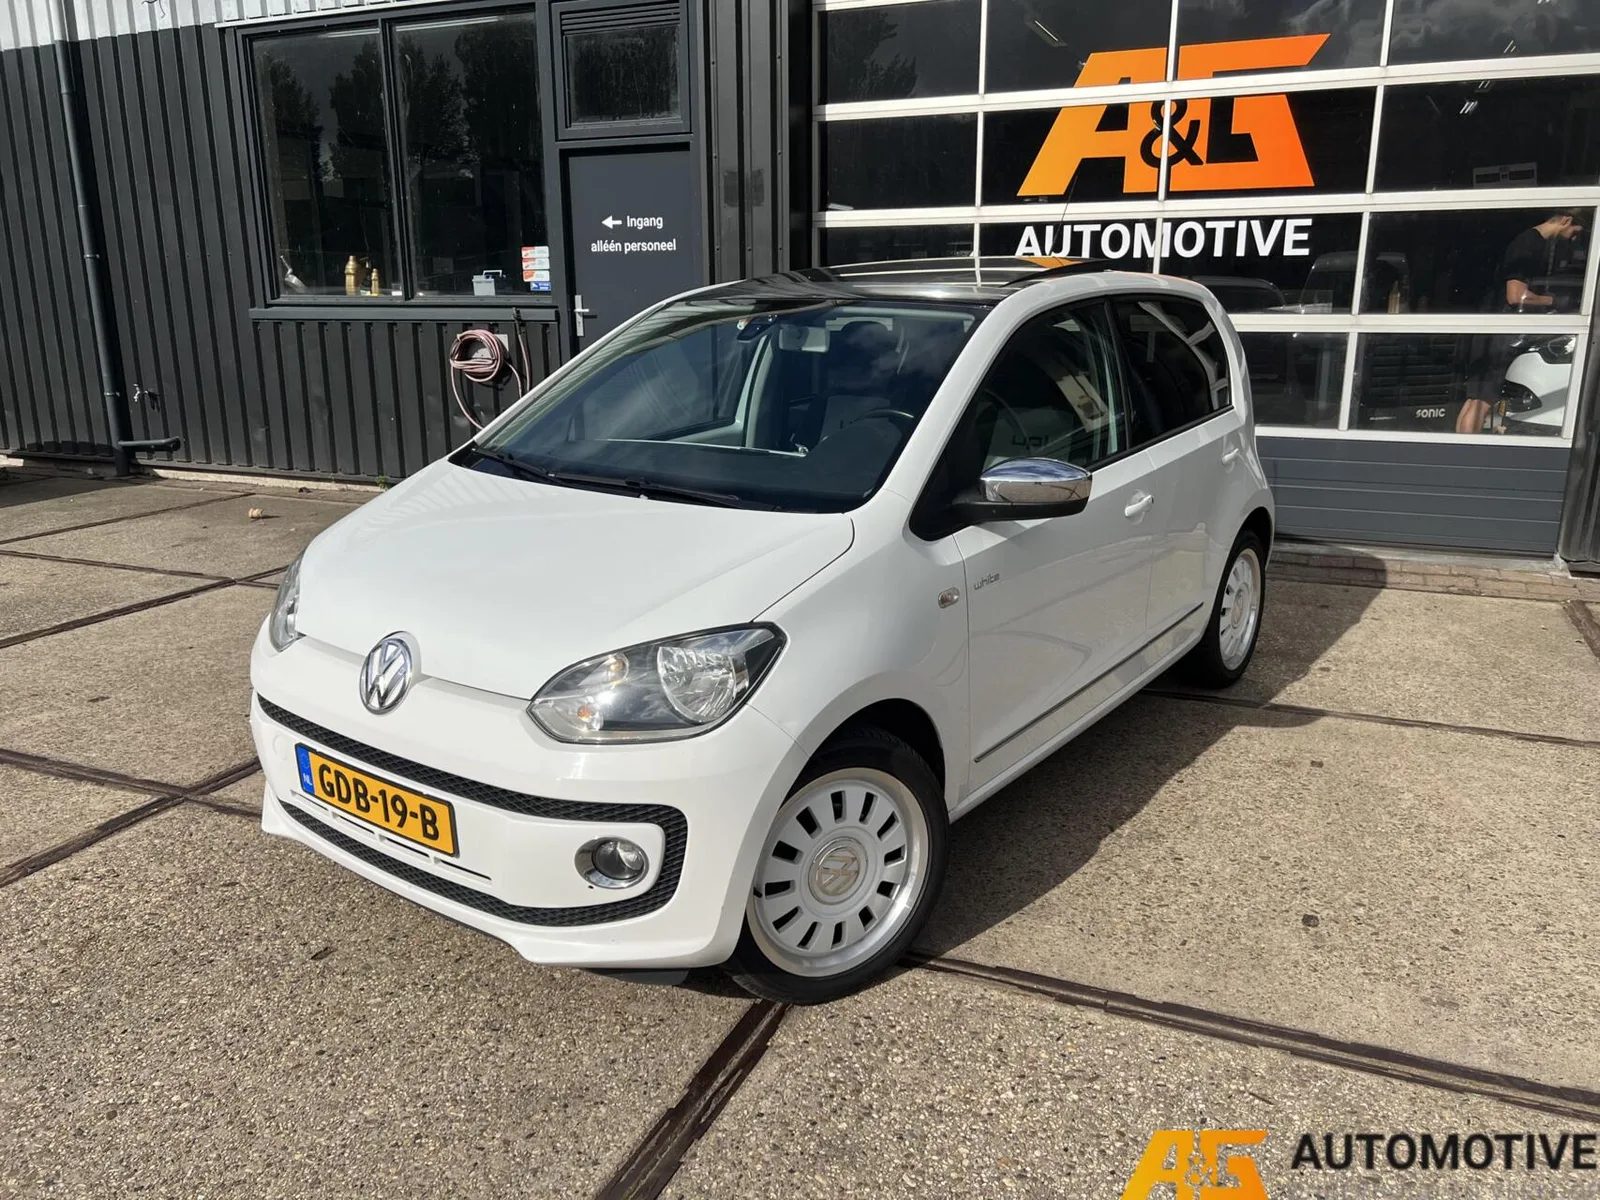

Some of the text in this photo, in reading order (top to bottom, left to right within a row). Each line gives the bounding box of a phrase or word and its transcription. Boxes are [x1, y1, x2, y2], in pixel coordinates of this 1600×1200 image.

[1016, 33, 1331, 197] A&G
[626, 215, 664, 230] Ingang
[590, 238, 677, 254] alléén personeel
[1015, 218, 1313, 260] AUTOMOTIVE
[973, 573, 1000, 590] white
[302, 772, 313, 787] NL
[318, 763, 440, 841] GDB-19-B
